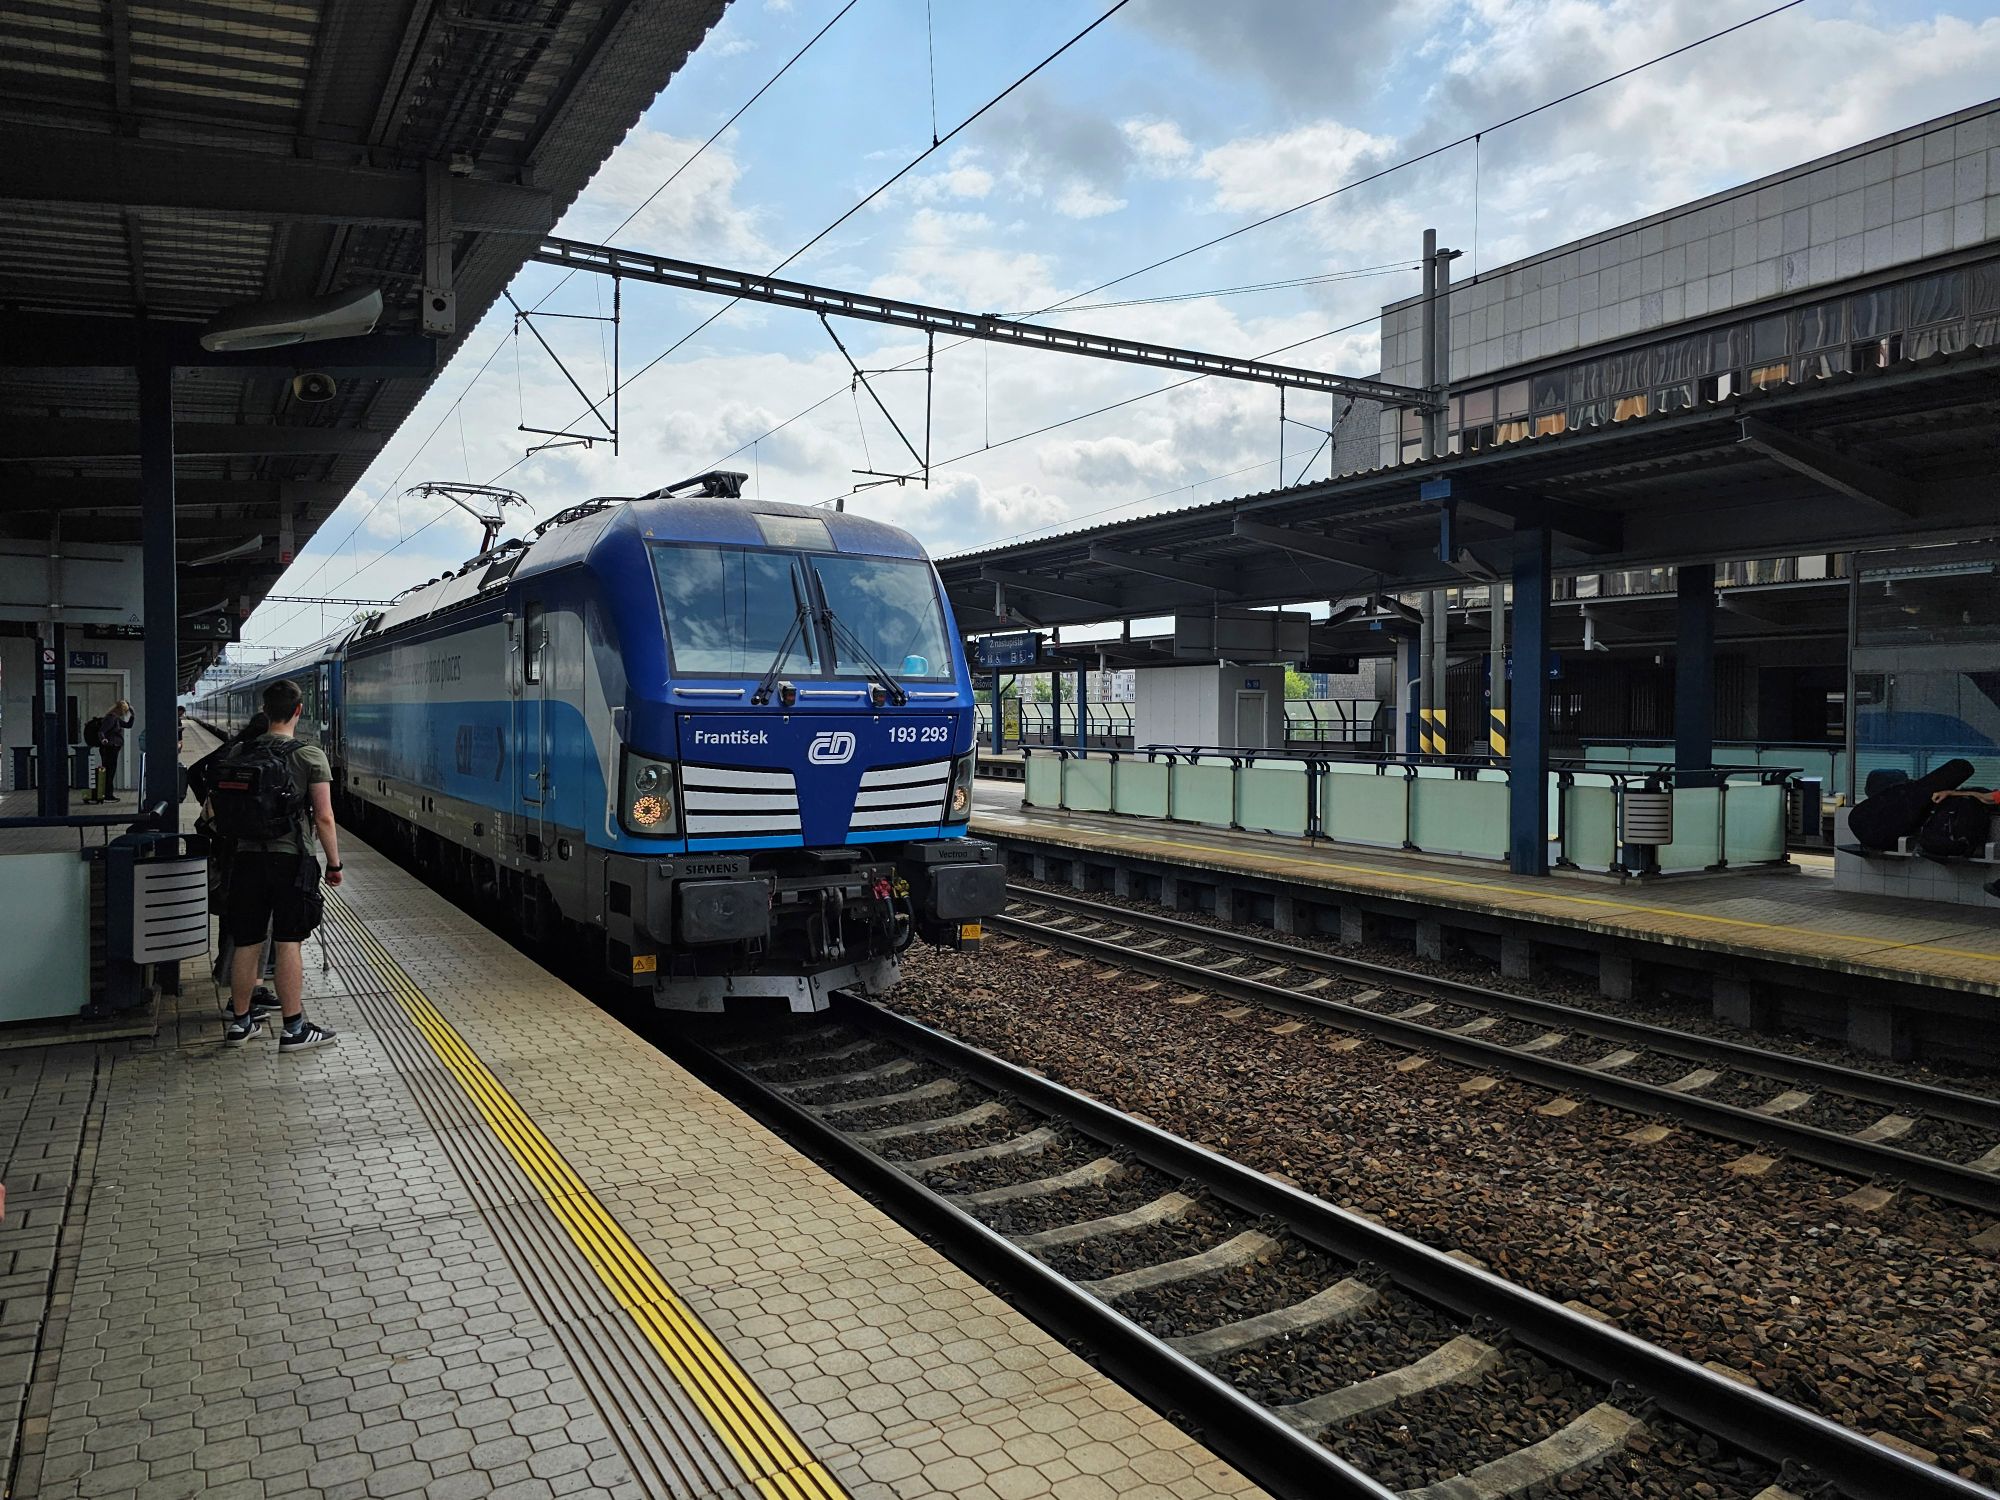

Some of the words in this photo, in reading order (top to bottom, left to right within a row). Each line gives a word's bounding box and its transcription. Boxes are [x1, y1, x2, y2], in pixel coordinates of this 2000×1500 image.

[694, 730, 769, 746] František
[888, 727, 917, 743] 193
[920, 726, 949, 742] 293
[938, 849, 968, 859] Vectron
[685, 863, 739, 876] SIEMENS
